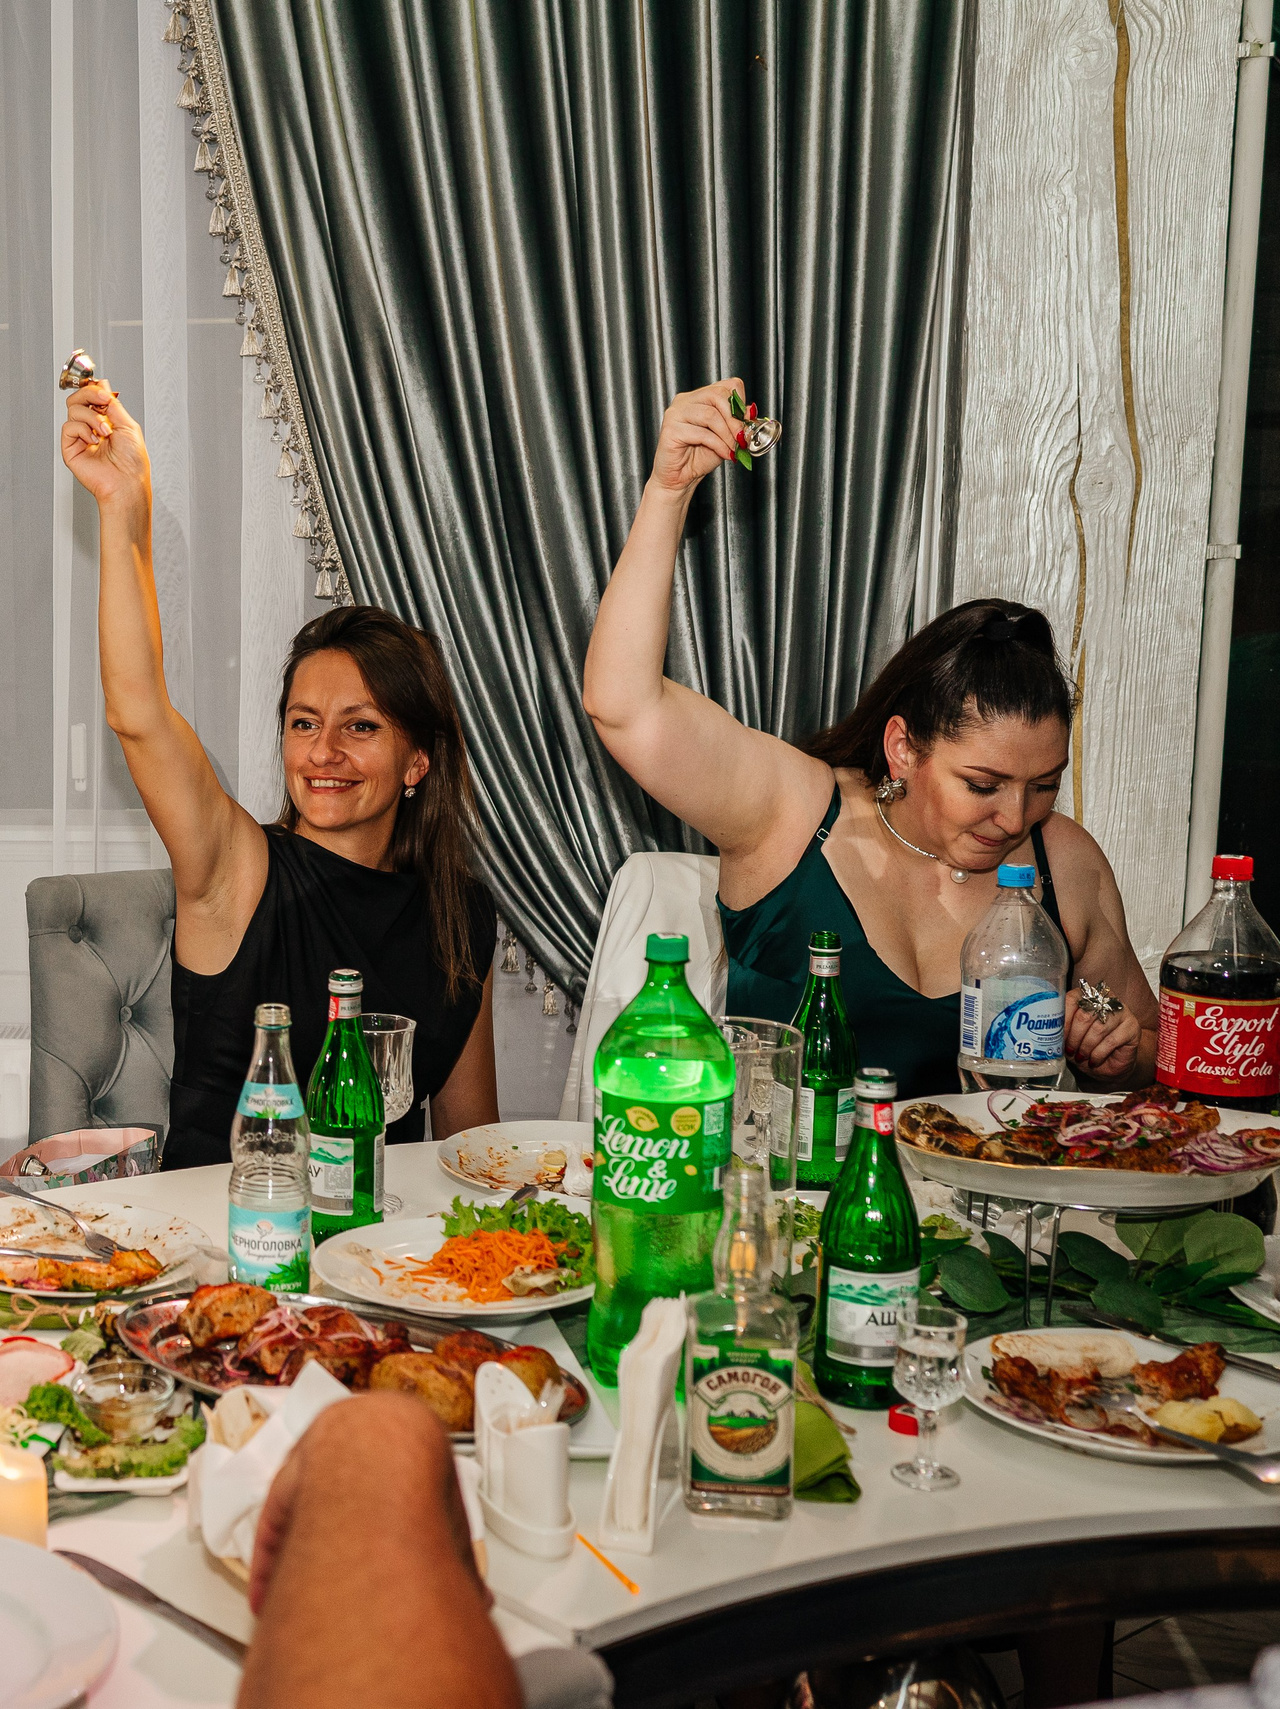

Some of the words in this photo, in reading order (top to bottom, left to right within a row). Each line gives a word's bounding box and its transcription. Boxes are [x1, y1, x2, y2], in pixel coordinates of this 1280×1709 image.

[1195, 1006, 1279, 1044] Export
[1204, 1031, 1265, 1065] Style
[1186, 1056, 1237, 1077] Classic
[1239, 1057, 1273, 1077] Cola
[597, 1114, 693, 1162] Lemon
[602, 1157, 677, 1203] Lime
[647, 1159, 667, 1180] &
[232, 1233, 303, 1251] ЧЕРНОГОЛОВКА
[706, 1371, 782, 1395] САМОГОН
